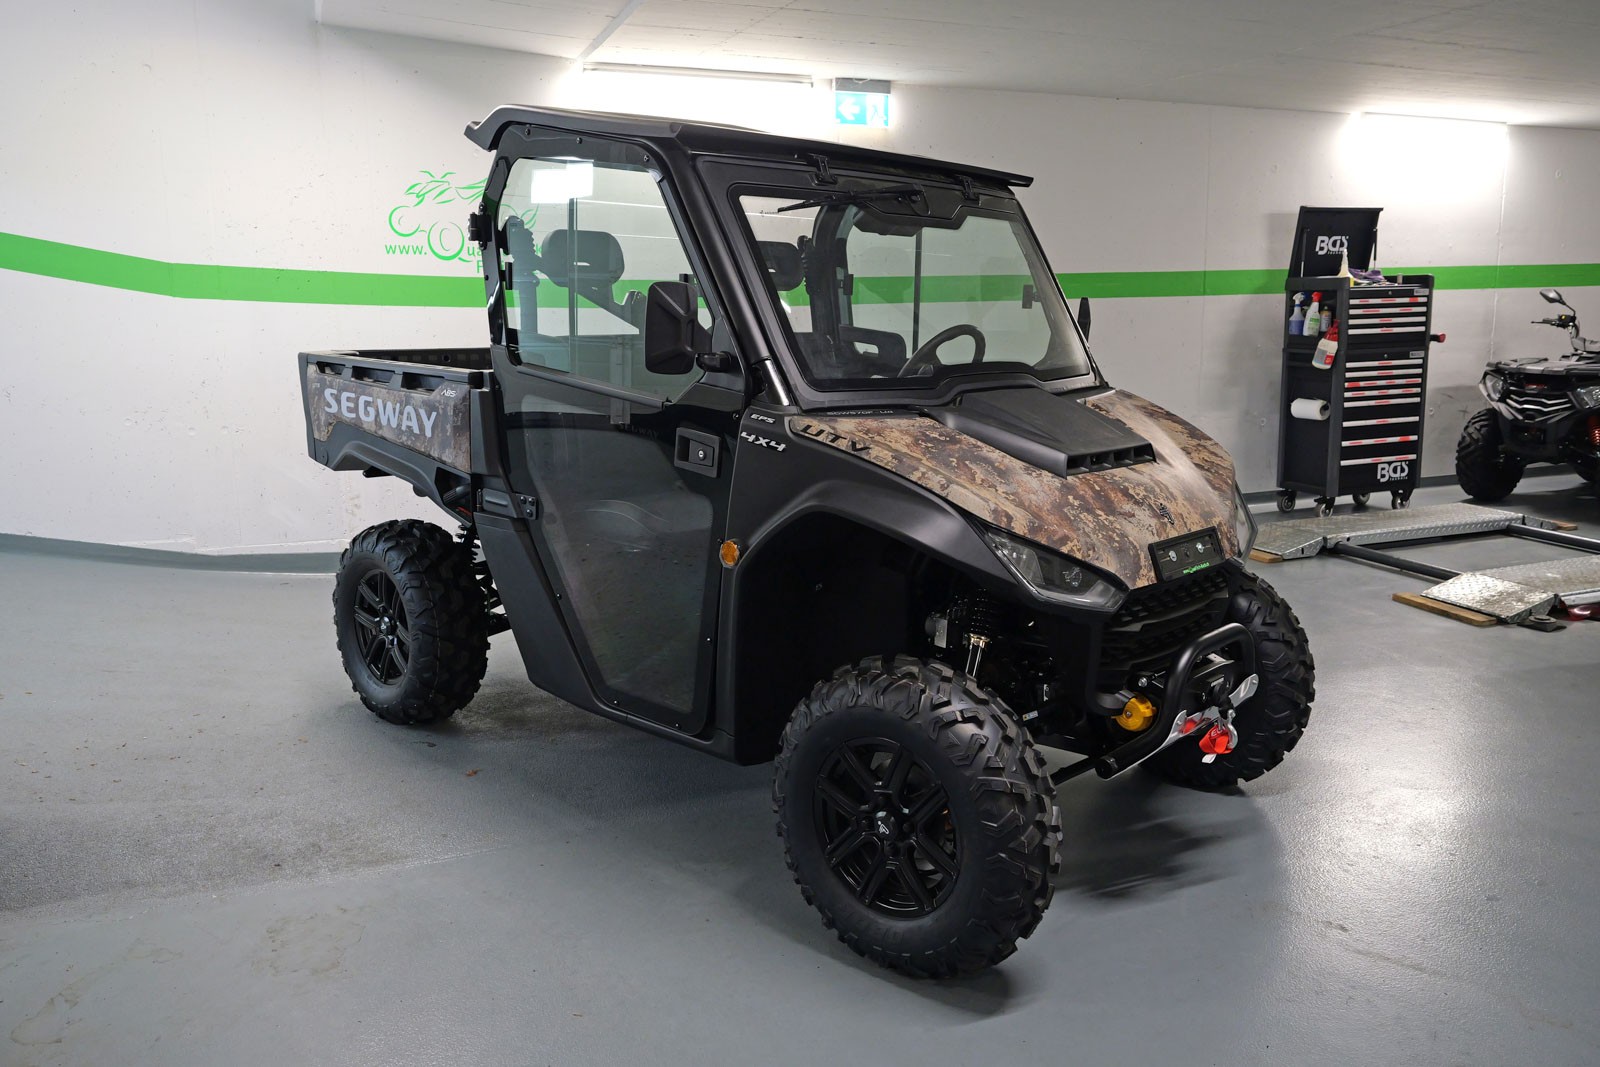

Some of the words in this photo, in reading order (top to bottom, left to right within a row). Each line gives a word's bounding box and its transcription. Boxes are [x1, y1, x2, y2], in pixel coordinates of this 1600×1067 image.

[1315, 235, 1349, 255] BGS
[324, 388, 437, 438] SEGWAY
[750, 413, 776, 424] EPS
[801, 424, 872, 452] UTV
[1376, 461, 1409, 483] BGS
